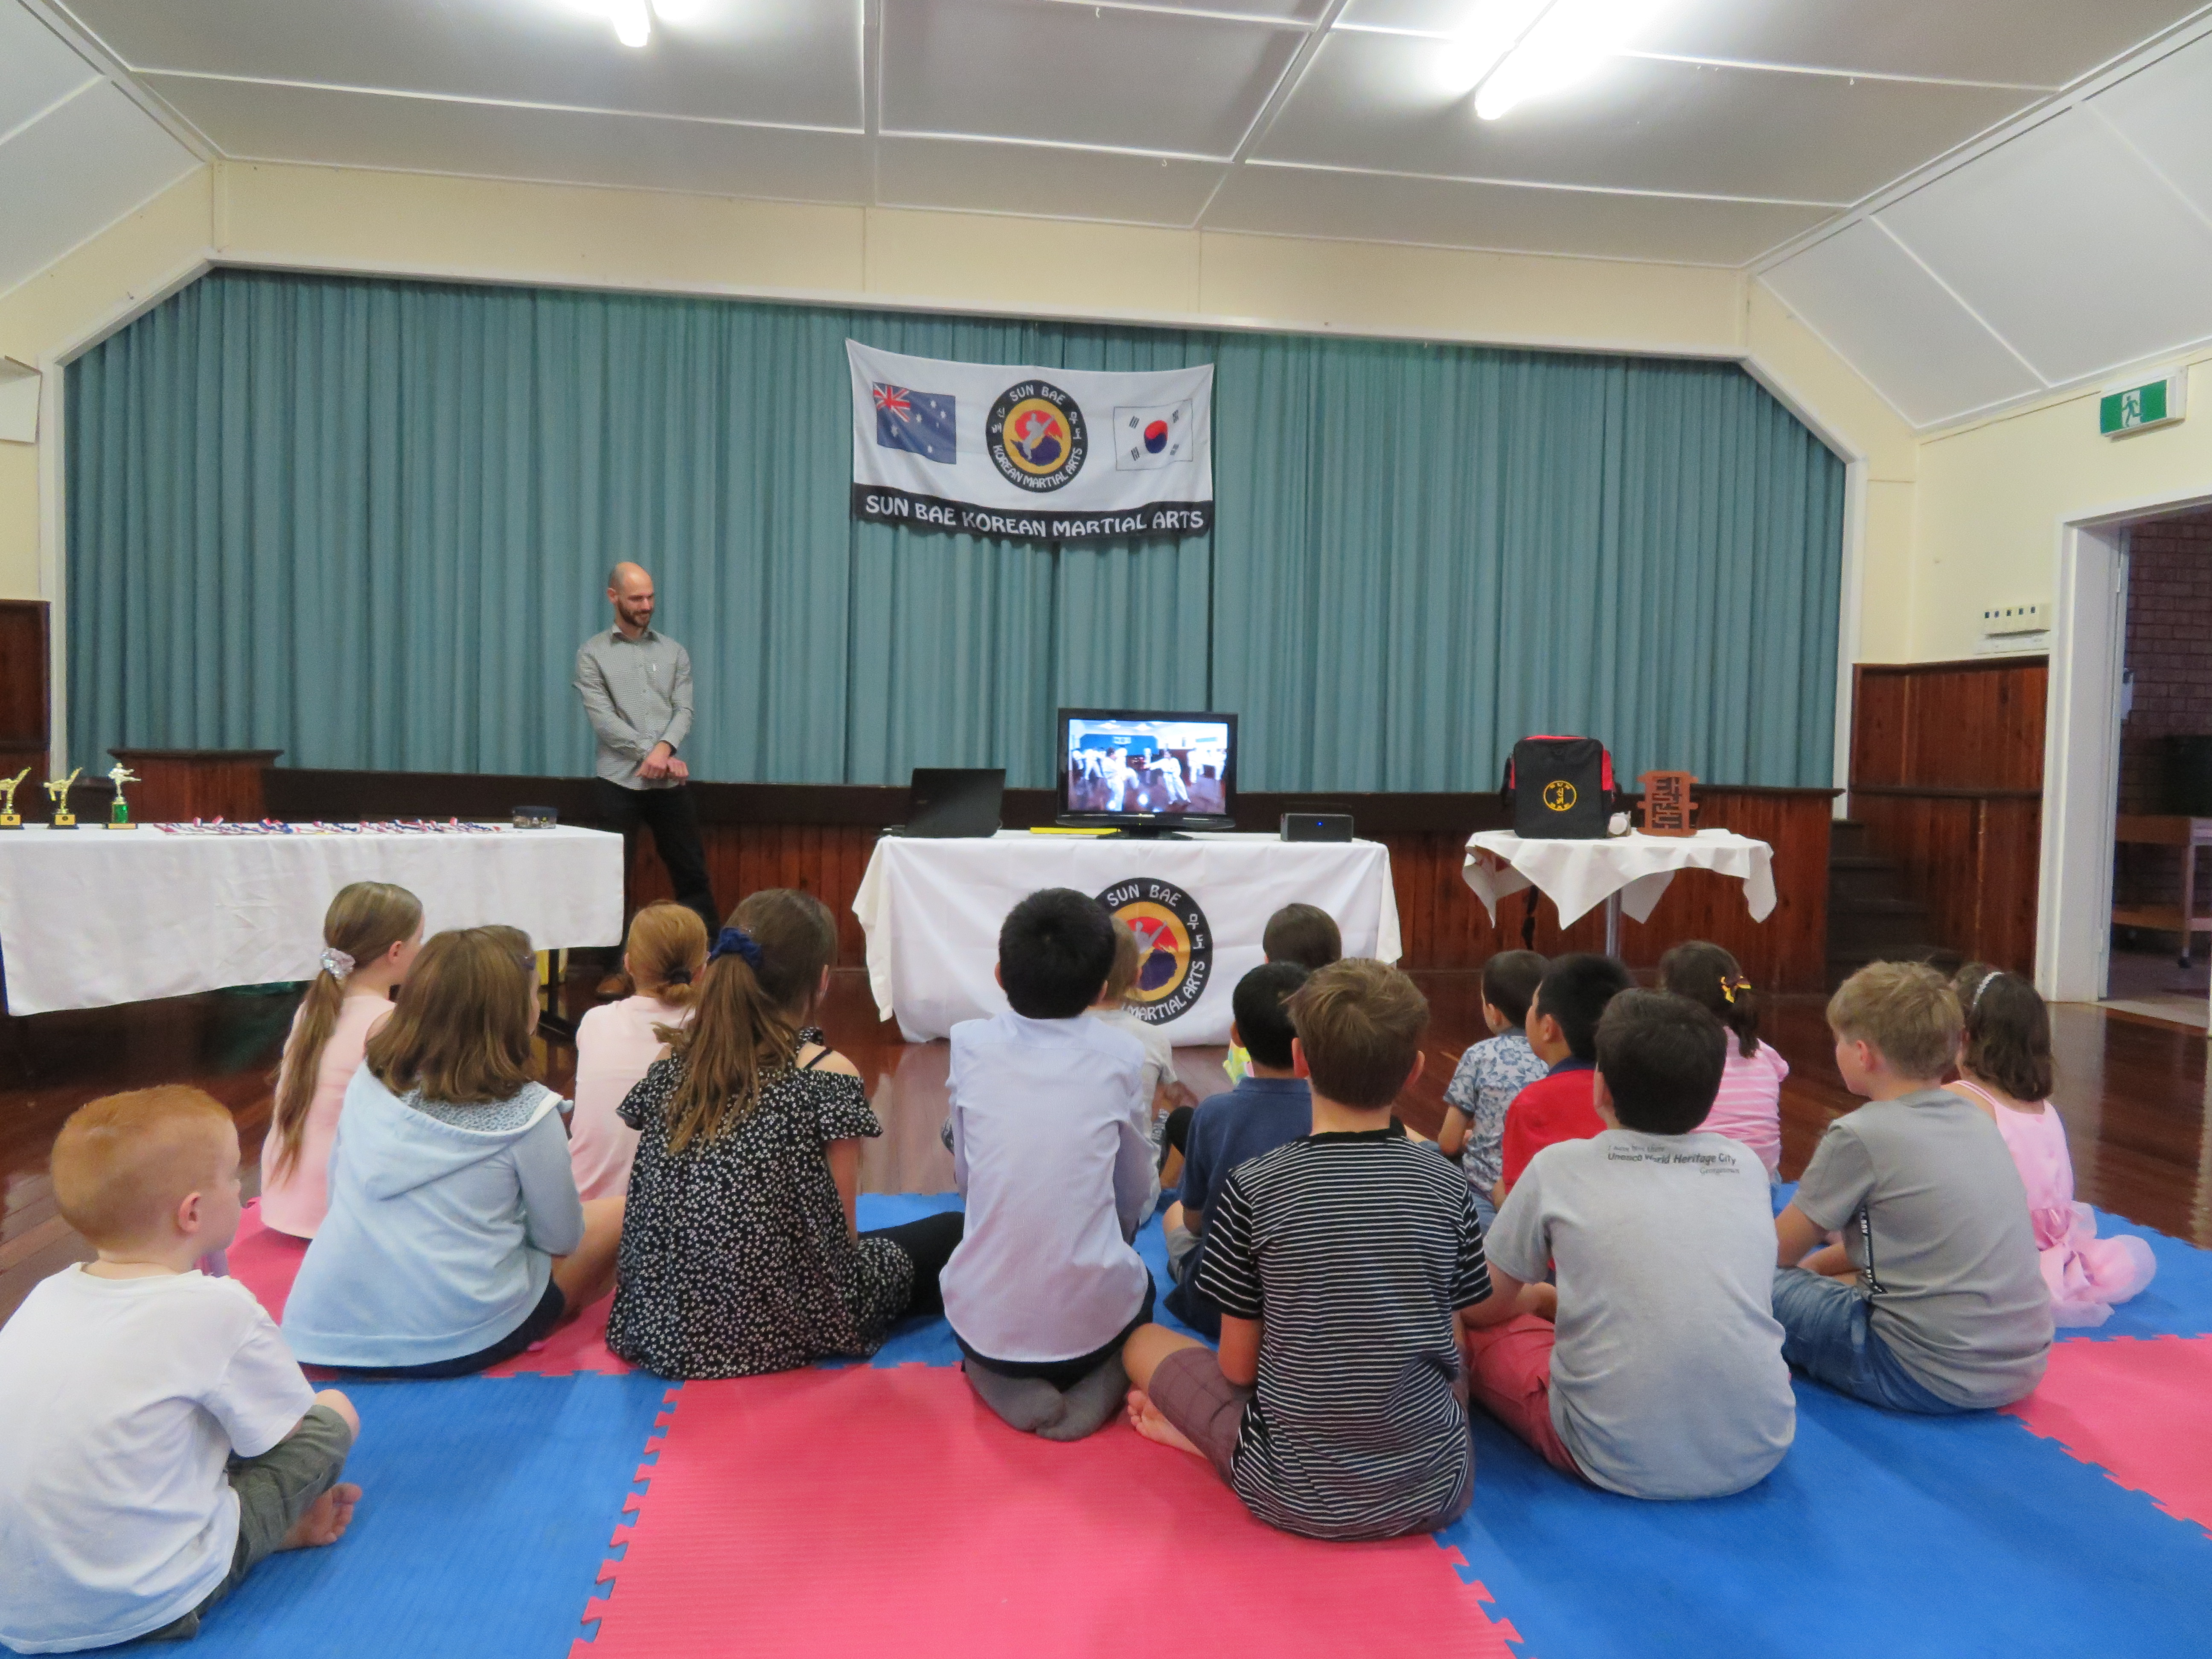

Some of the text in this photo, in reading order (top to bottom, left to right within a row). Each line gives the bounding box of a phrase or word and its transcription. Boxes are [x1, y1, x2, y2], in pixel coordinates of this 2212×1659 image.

[1010, 384, 1066, 405] SUN BAE
[993, 445, 1083, 488] KOREAN MARTIAL ARTS
[866, 495, 1204, 537] SUN BAE KOREAN MARTIAL ARTS
[1107, 884, 1182, 907] SUN BAE
[1187, 914, 1205, 949] 무도
[1127, 960, 1205, 1020] MARTIAL ARTS
[1607, 1153, 1736, 1166] Unesco World Heritage City
